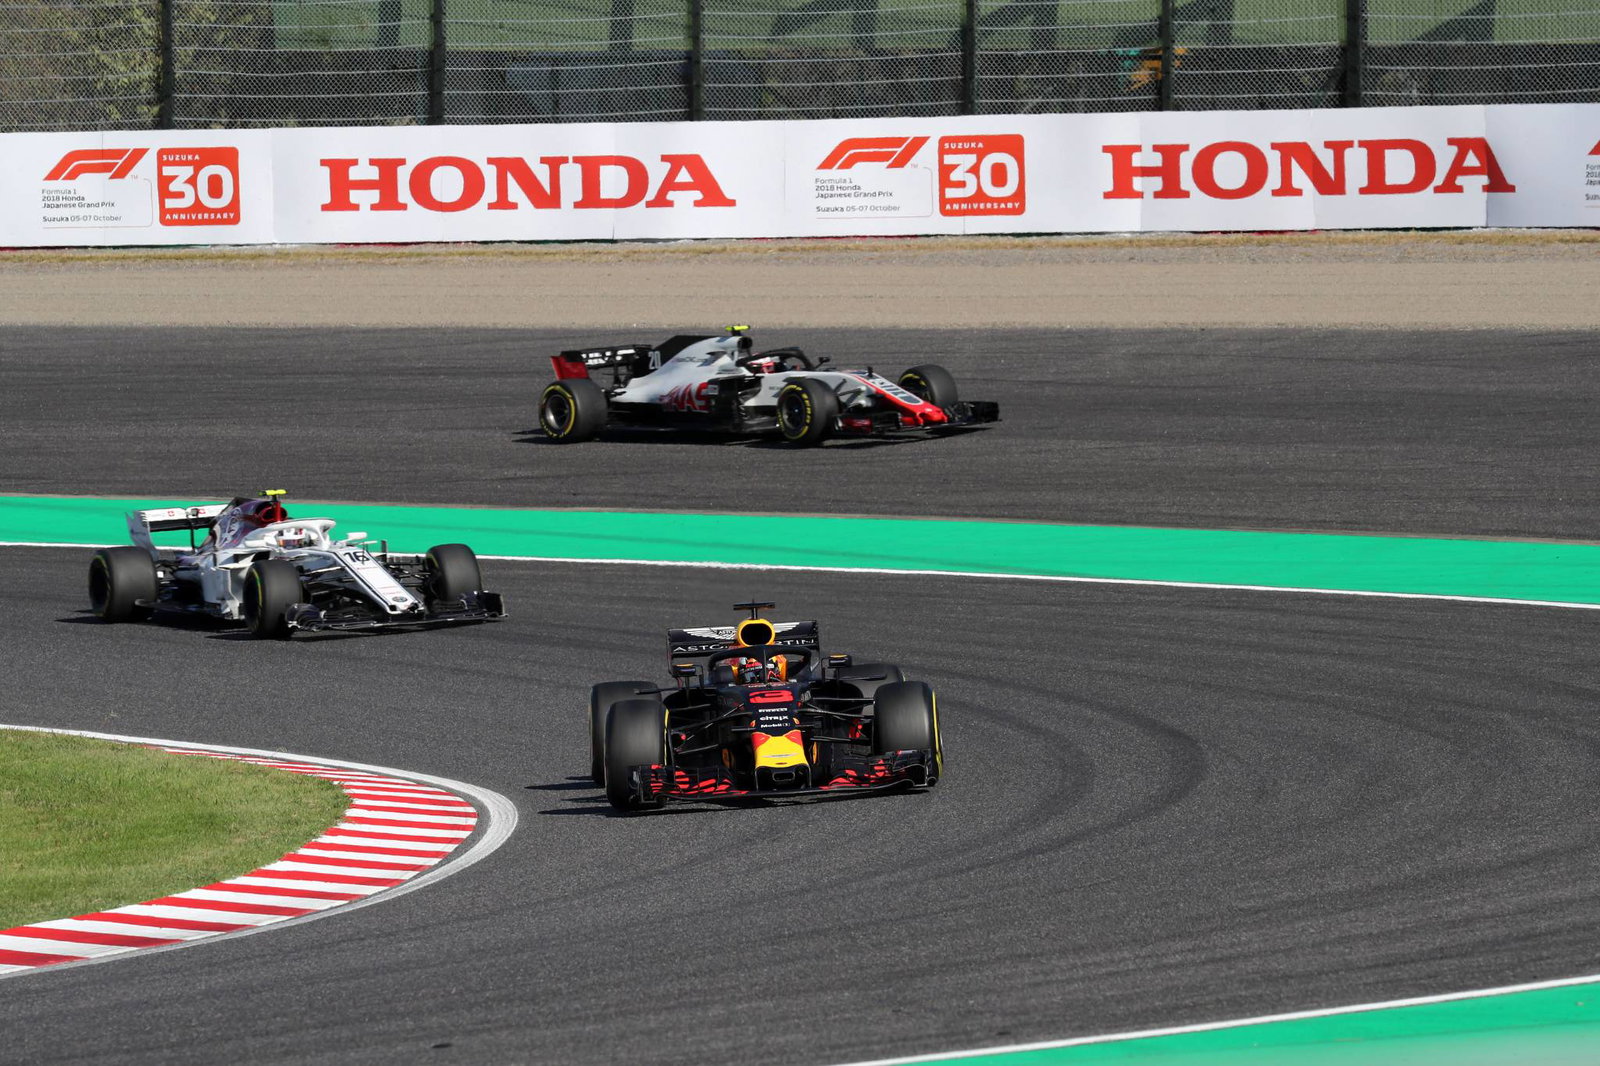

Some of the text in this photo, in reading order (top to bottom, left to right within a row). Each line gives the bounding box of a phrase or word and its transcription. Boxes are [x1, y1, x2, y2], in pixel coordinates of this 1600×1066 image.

[319, 154, 737, 212] HONDA
[943, 152, 1019, 199] 30
[1102, 137, 1516, 199] HONDA
[162, 164, 234, 209] 30
[165, 212, 235, 220] ANNIVERSARY
[945, 202, 1020, 210] ANNIVERSARY
[648, 351, 661, 370] 20
[343, 551, 370, 562] 16
